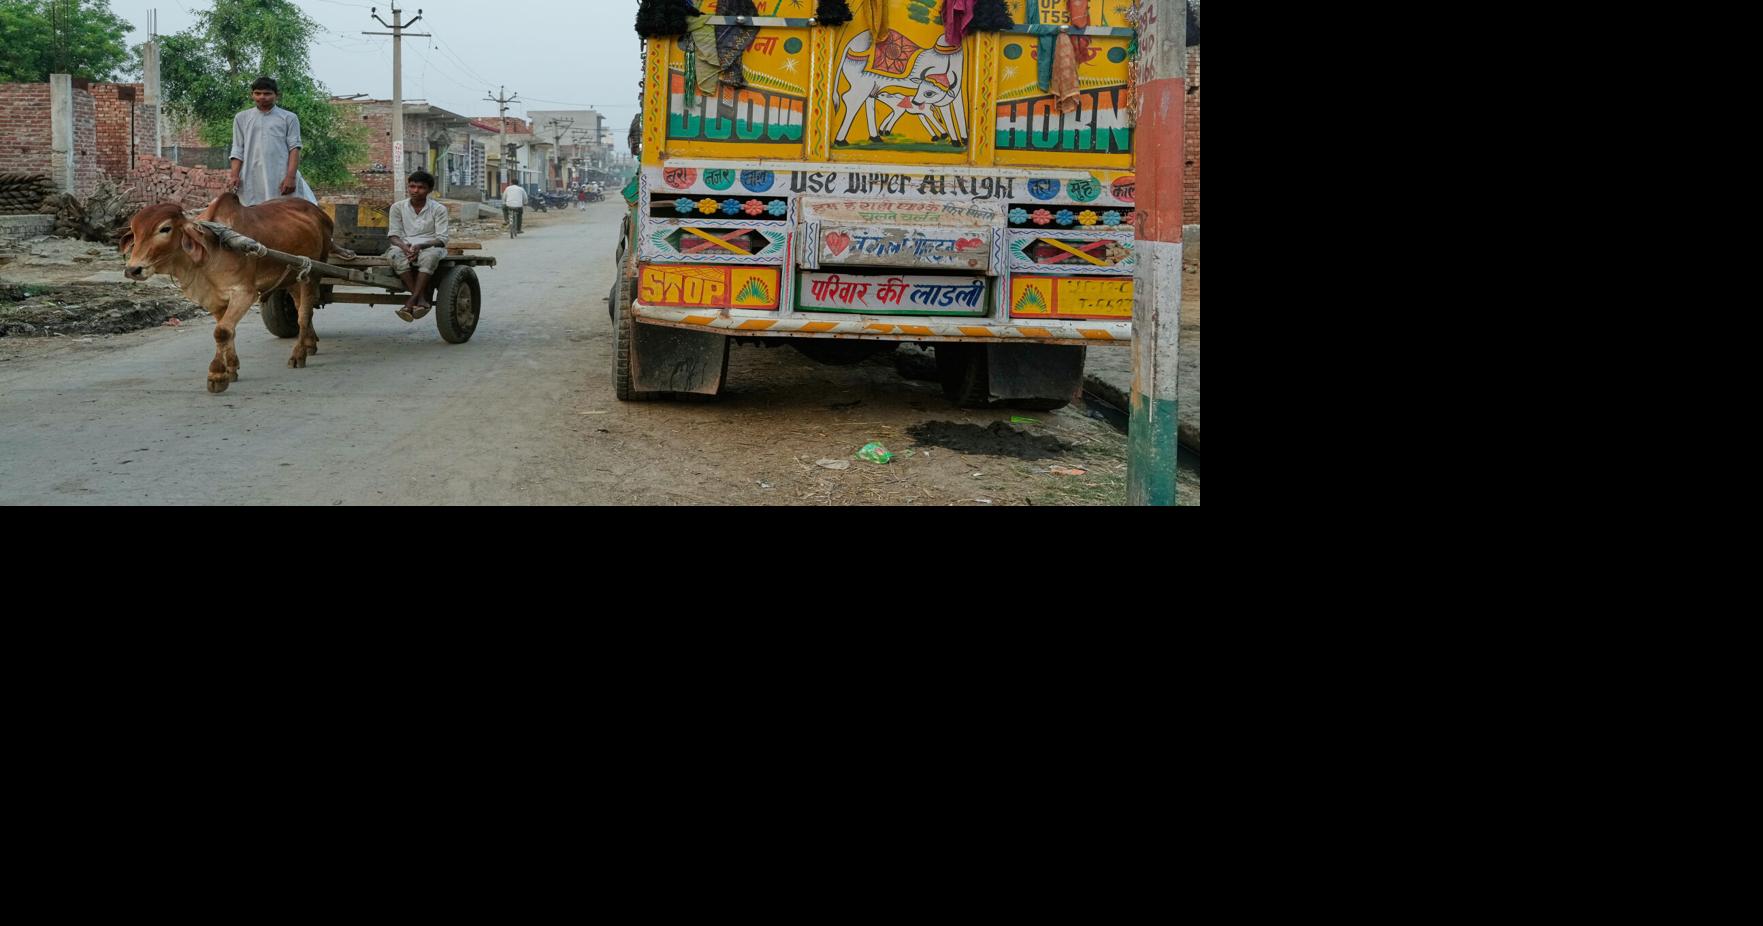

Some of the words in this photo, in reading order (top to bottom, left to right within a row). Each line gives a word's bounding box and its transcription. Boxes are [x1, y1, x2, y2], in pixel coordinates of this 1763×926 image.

[996, 87, 1130, 151] HORN
[641, 268, 725, 304] STOP
[811, 274, 872, 306] परिवार
[876, 277, 910, 305] की
[910, 280, 986, 308] लाडली
